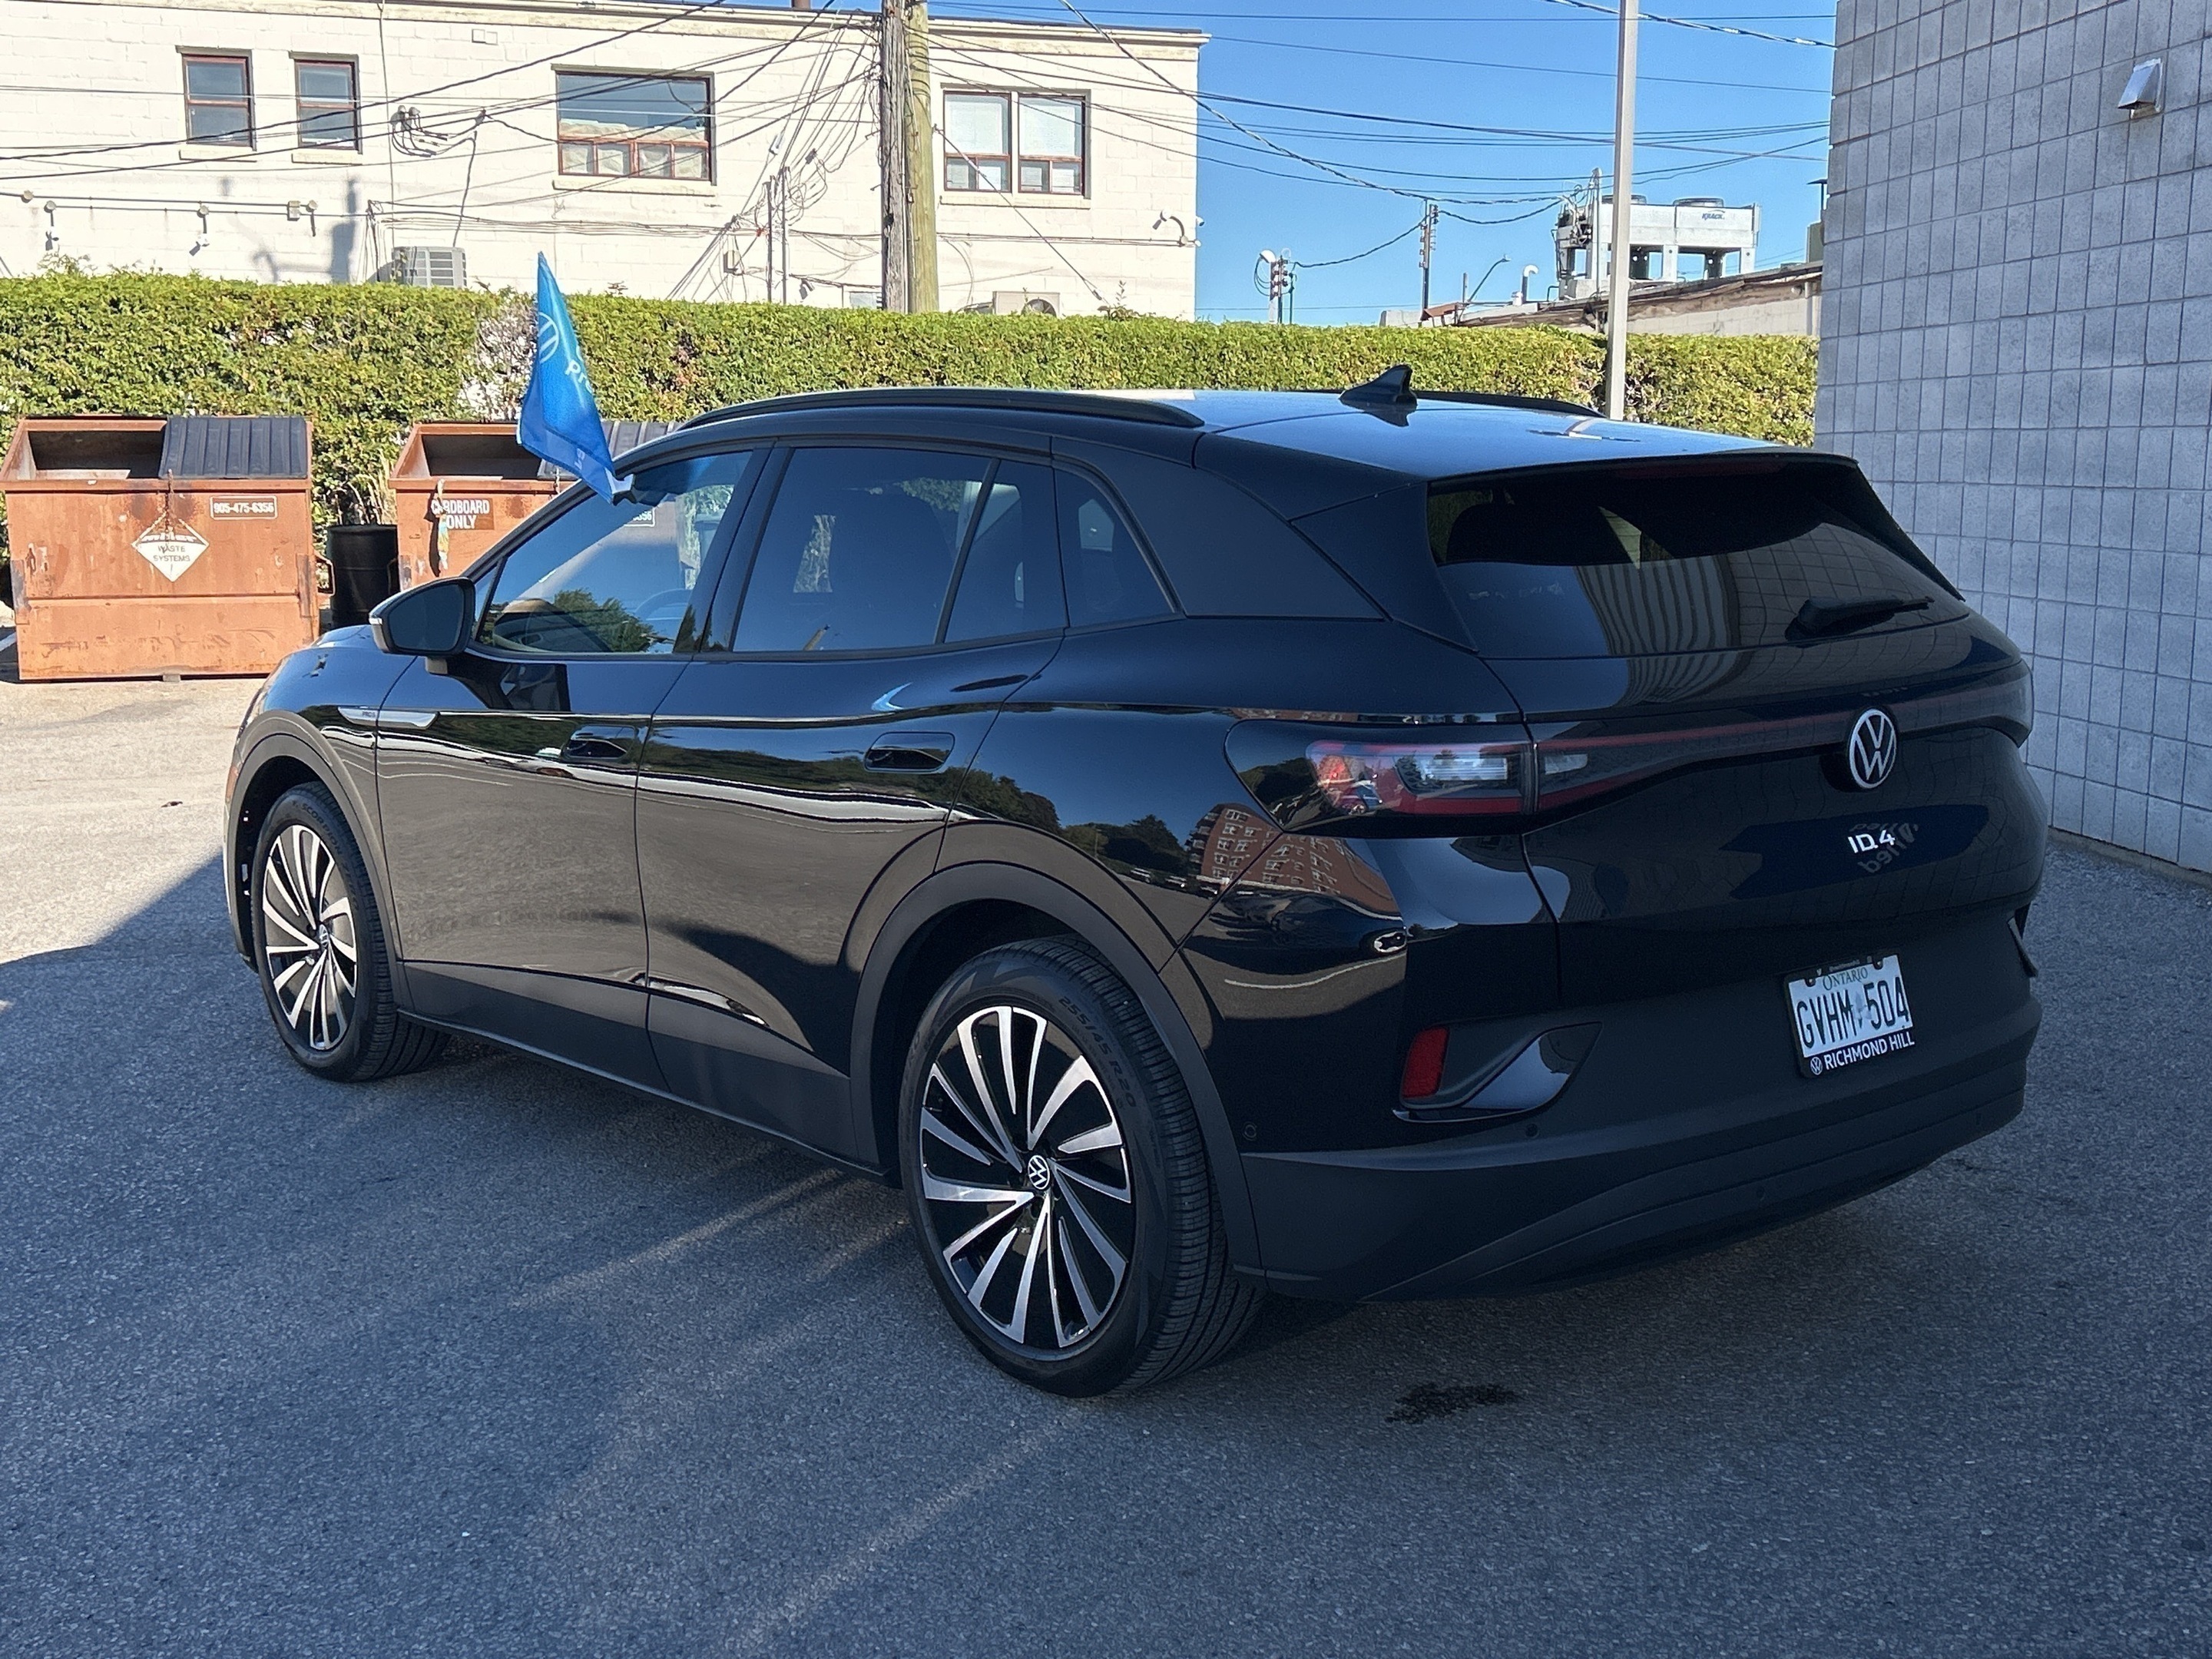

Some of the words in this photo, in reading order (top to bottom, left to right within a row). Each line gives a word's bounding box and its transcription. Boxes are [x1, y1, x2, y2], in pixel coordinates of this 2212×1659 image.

[446, 515, 477, 528] ONLY
[1822, 967, 1869, 991] ONTARIO
[1796, 988, 1857, 1049] GVHM
[1863, 976, 1909, 1030] 504
[1823, 1038, 1888, 1071] RICHMOND
[1889, 1031, 1916, 1051] HILL
